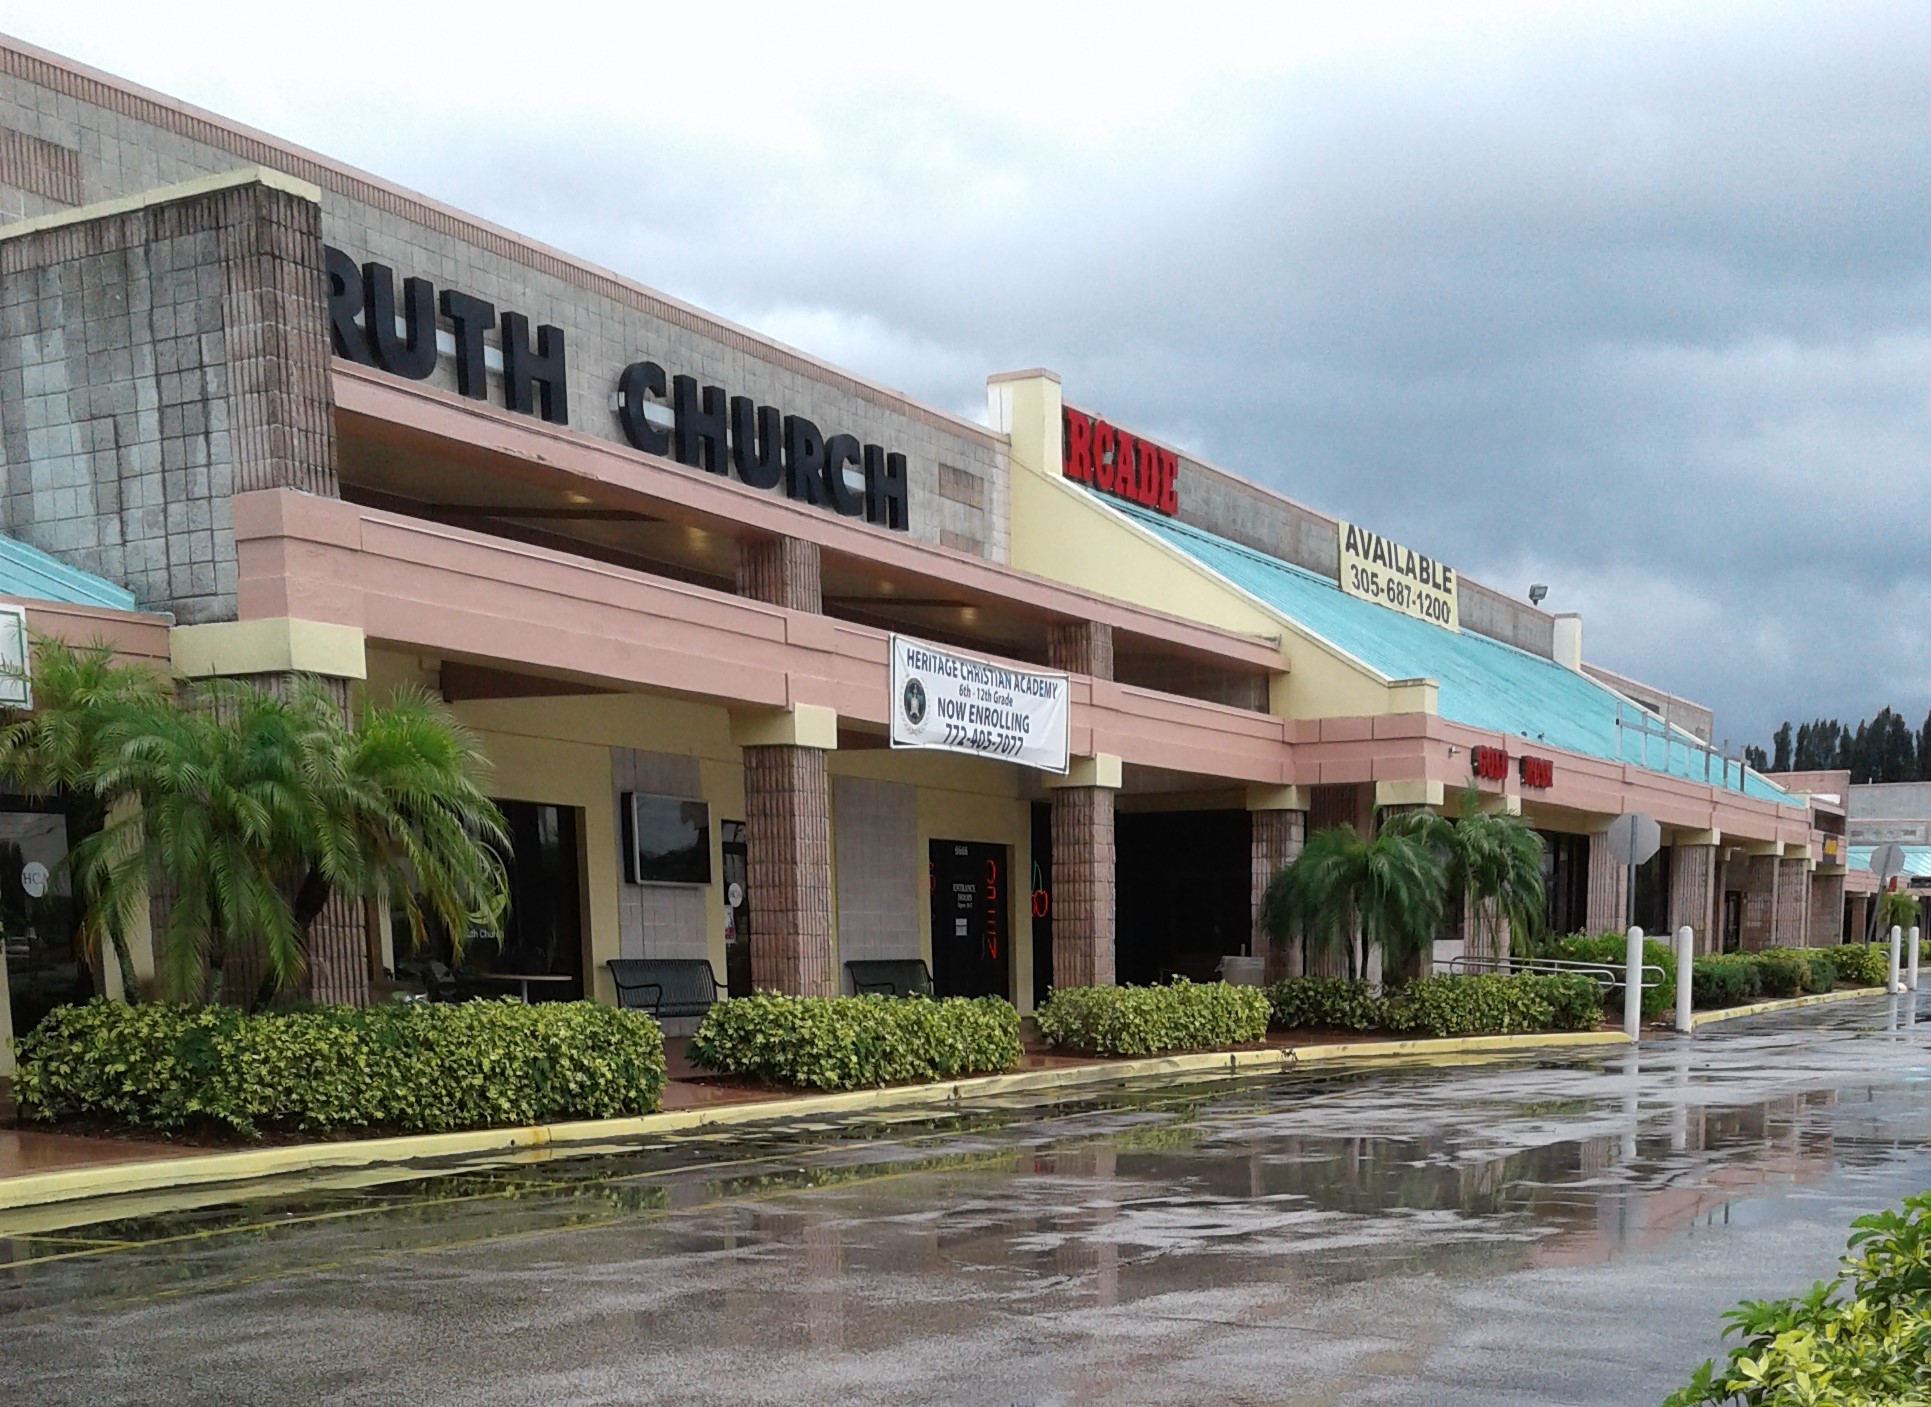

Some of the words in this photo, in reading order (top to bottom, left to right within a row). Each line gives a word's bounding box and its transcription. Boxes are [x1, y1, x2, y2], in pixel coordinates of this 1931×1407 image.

[325, 244, 568, 425] RUTH
[617, 361, 909, 531] CHURCH
[1062, 407, 1178, 516] RCADE
[1345, 523, 1453, 595] AVAILABLE
[1351, 564, 1452, 625] 305-687-1200
[907, 648, 958, 678] HERITAGE
[960, 662, 1012, 690] CHRISTIAN
[1014, 674, 1058, 700] ACADEMY
[959, 684, 971, 698] 6th
[977, 687, 992, 703] 12th
[993, 691, 1014, 707] Grade
[937, 697, 967, 722] NOW
[969, 703, 1030, 734] ENROLLING
[943, 723, 1024, 756] 772-405-7077
[22, 872, 46, 885] HC
